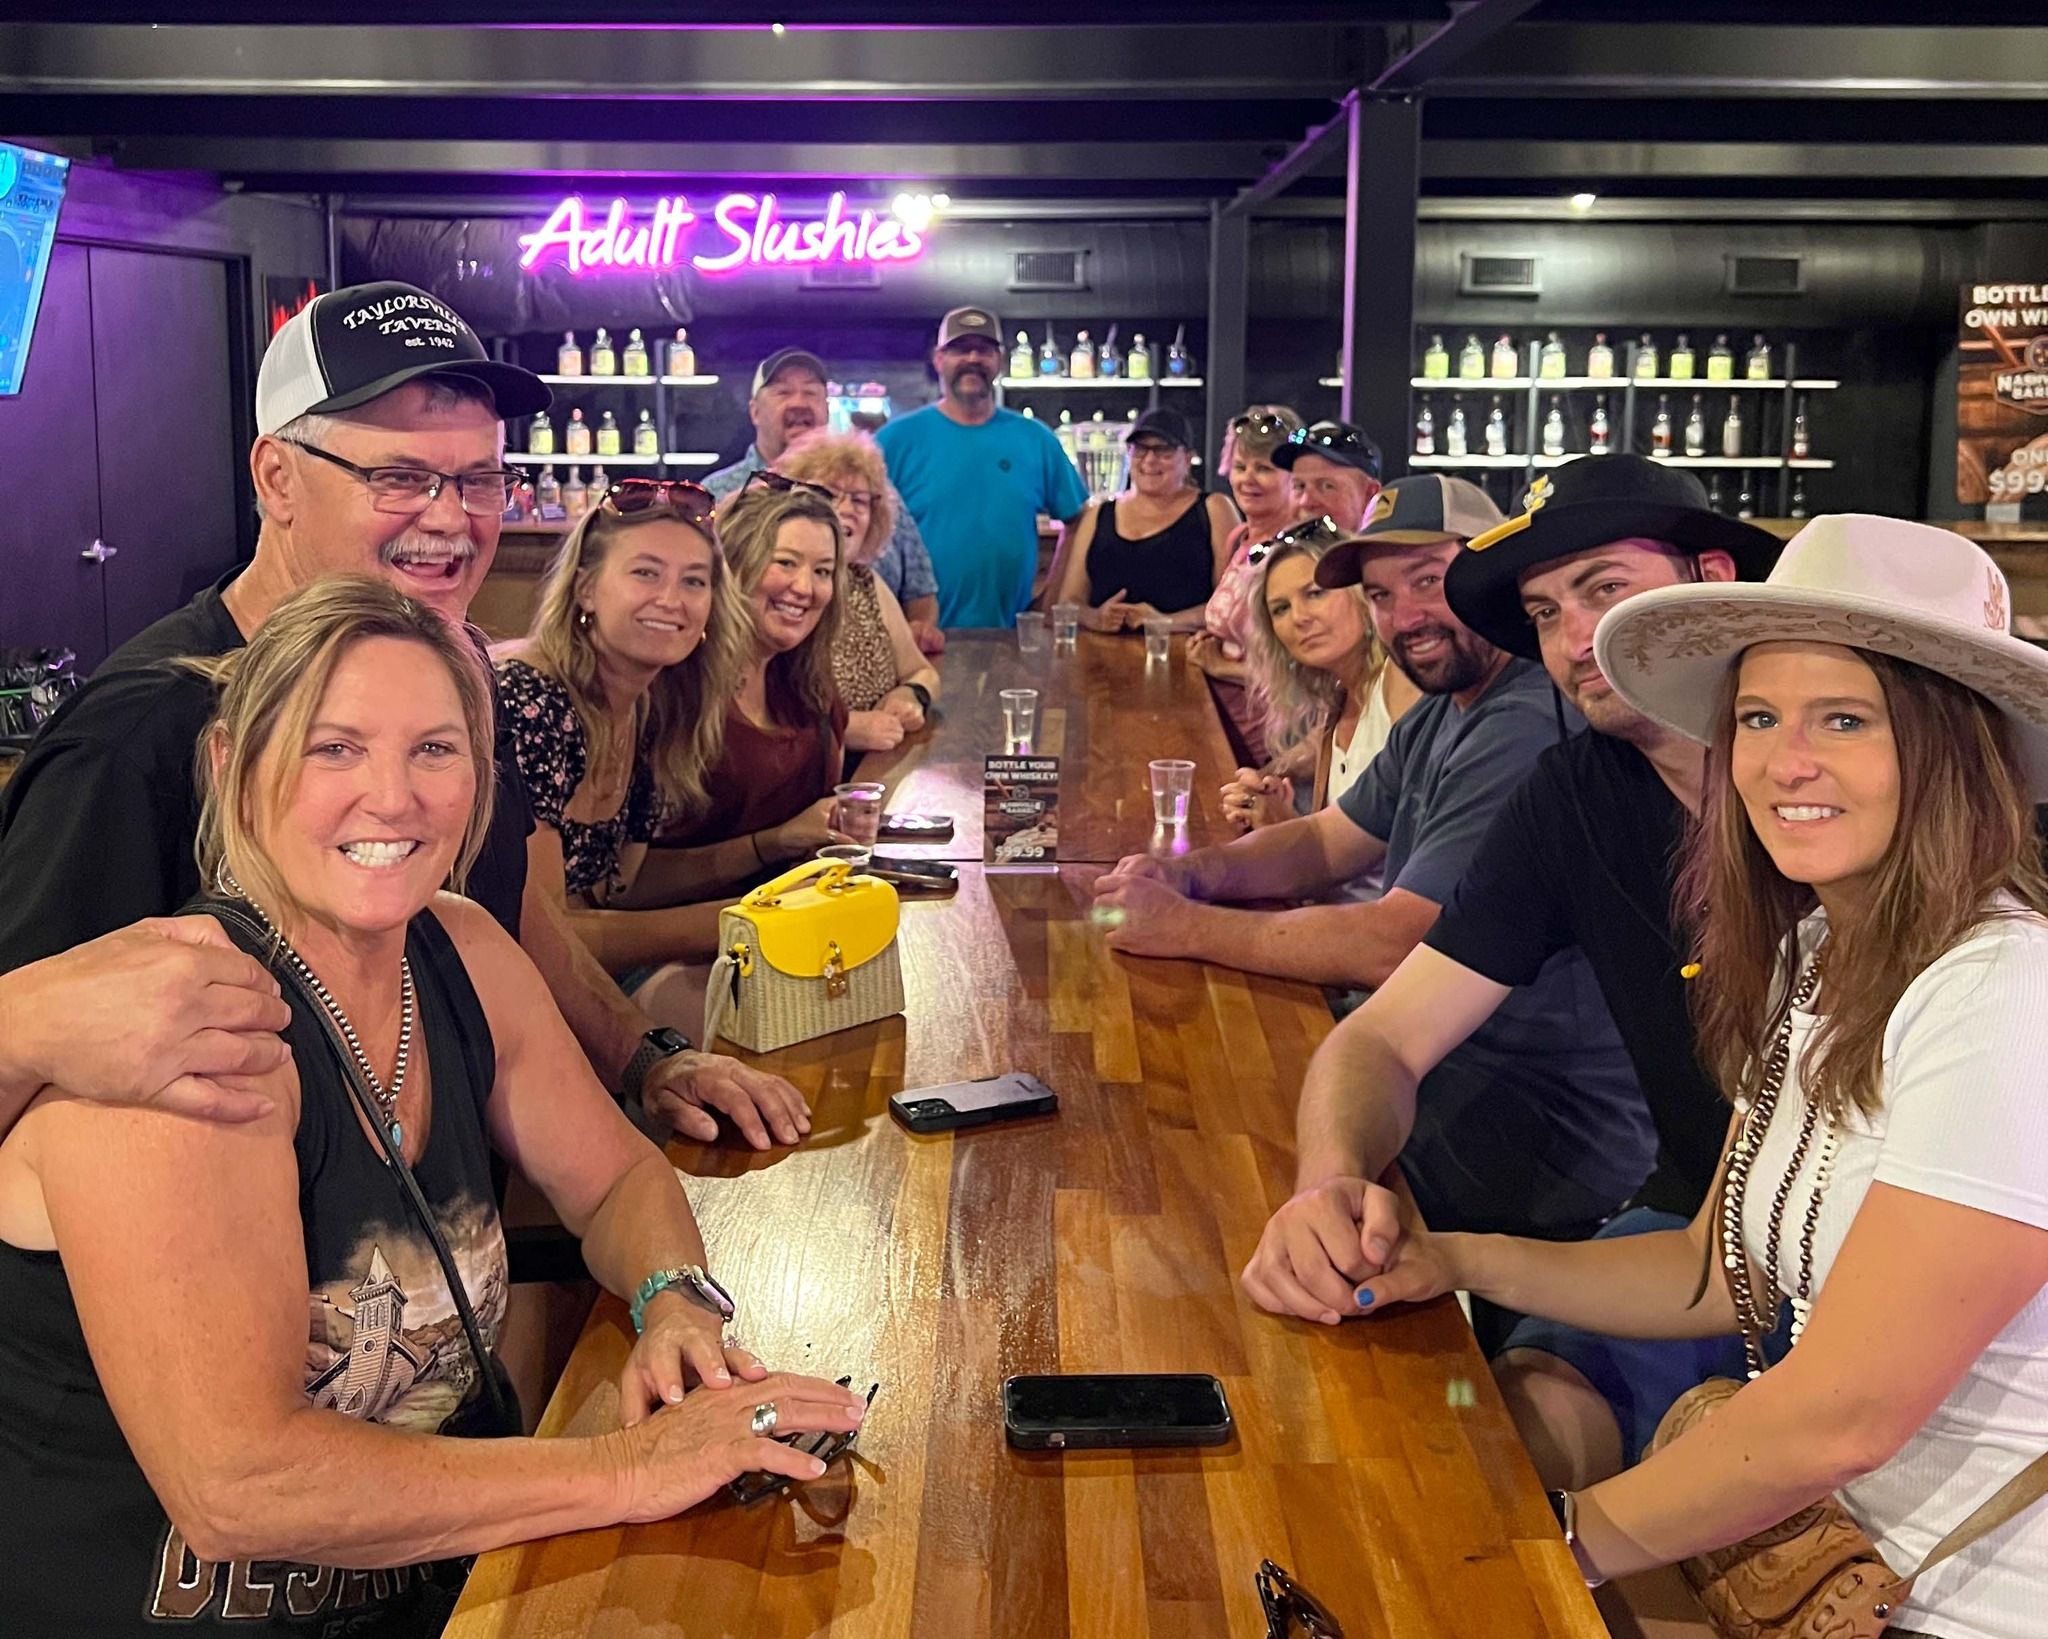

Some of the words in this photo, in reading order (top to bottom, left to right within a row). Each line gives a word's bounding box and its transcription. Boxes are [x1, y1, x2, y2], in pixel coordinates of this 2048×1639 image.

[518, 195, 695, 273] Adult
[693, 191, 924, 272] Slushies
[378, 316, 458, 336] TAVERN
[1964, 308, 2017, 328] OWN
[988, 761, 1026, 769] BOTTLE
[1029, 761, 1056, 769] YOUR
[985, 772, 1009, 780] OWN
